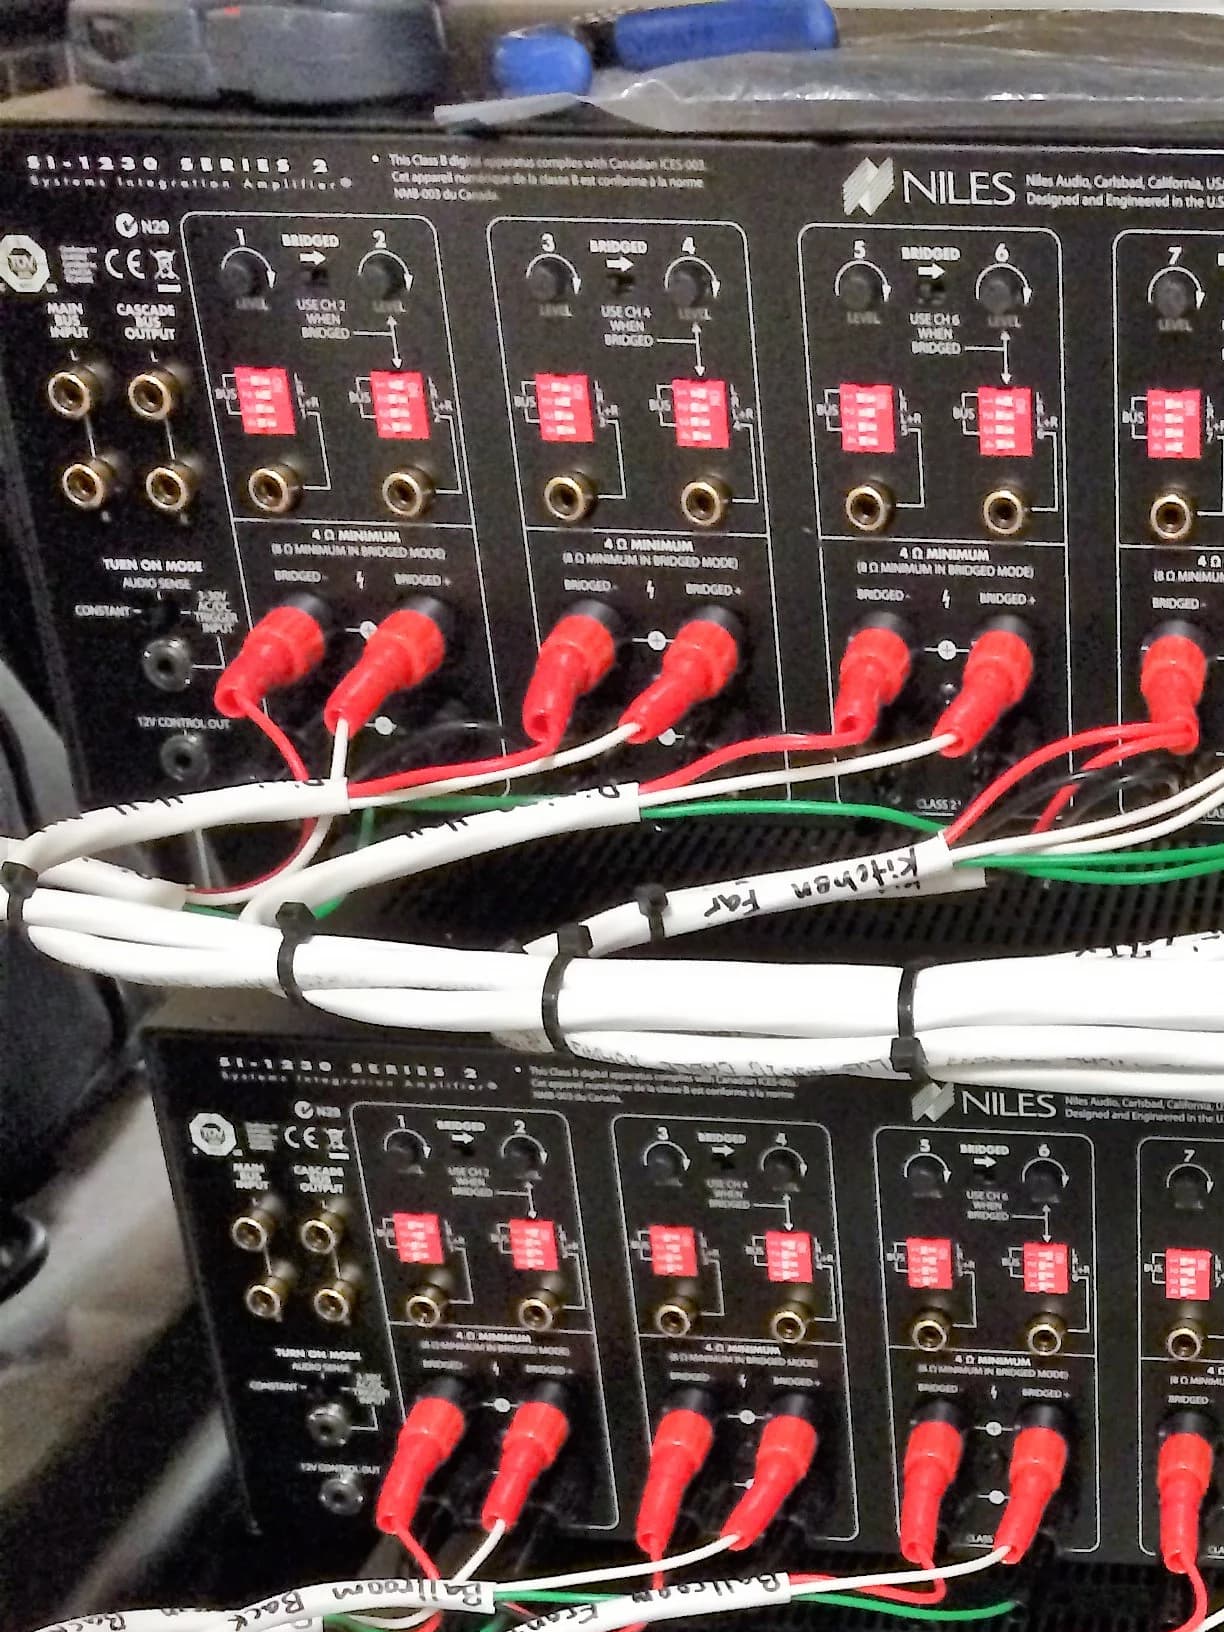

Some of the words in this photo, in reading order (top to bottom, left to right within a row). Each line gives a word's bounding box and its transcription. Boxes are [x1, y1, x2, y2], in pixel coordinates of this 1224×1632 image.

[313, 158, 329, 173] 2
[903, 170, 1016, 207] NILES
[1026, 173, 1055, 187] Niles
[1026, 192, 1079, 209] Designed
[1081, 194, 1103, 207] and
[1105, 193, 1170, 211] Engineered
[1185, 196, 1204, 209] the
[235, 228, 247, 246] 1
[281, 232, 340, 248] BRIDGED
[371, 229, 386, 248] 2
[541, 232, 556, 251] 3
[681, 236, 696, 255] 4
[589, 239, 648, 255] BRIDGED
[853, 240, 866, 259] 5
[901, 246, 961, 262] BRIDGED
[995, 243, 1010, 262] 6
[1167, 246, 1182, 265] 7
[47, 302, 83, 317] MAIN
[116, 302, 176, 317] CASCADE
[50, 326, 89, 340] INPUT
[124, 326, 177, 341] OUTPUT
[962, 1089, 1058, 1119] NILES
